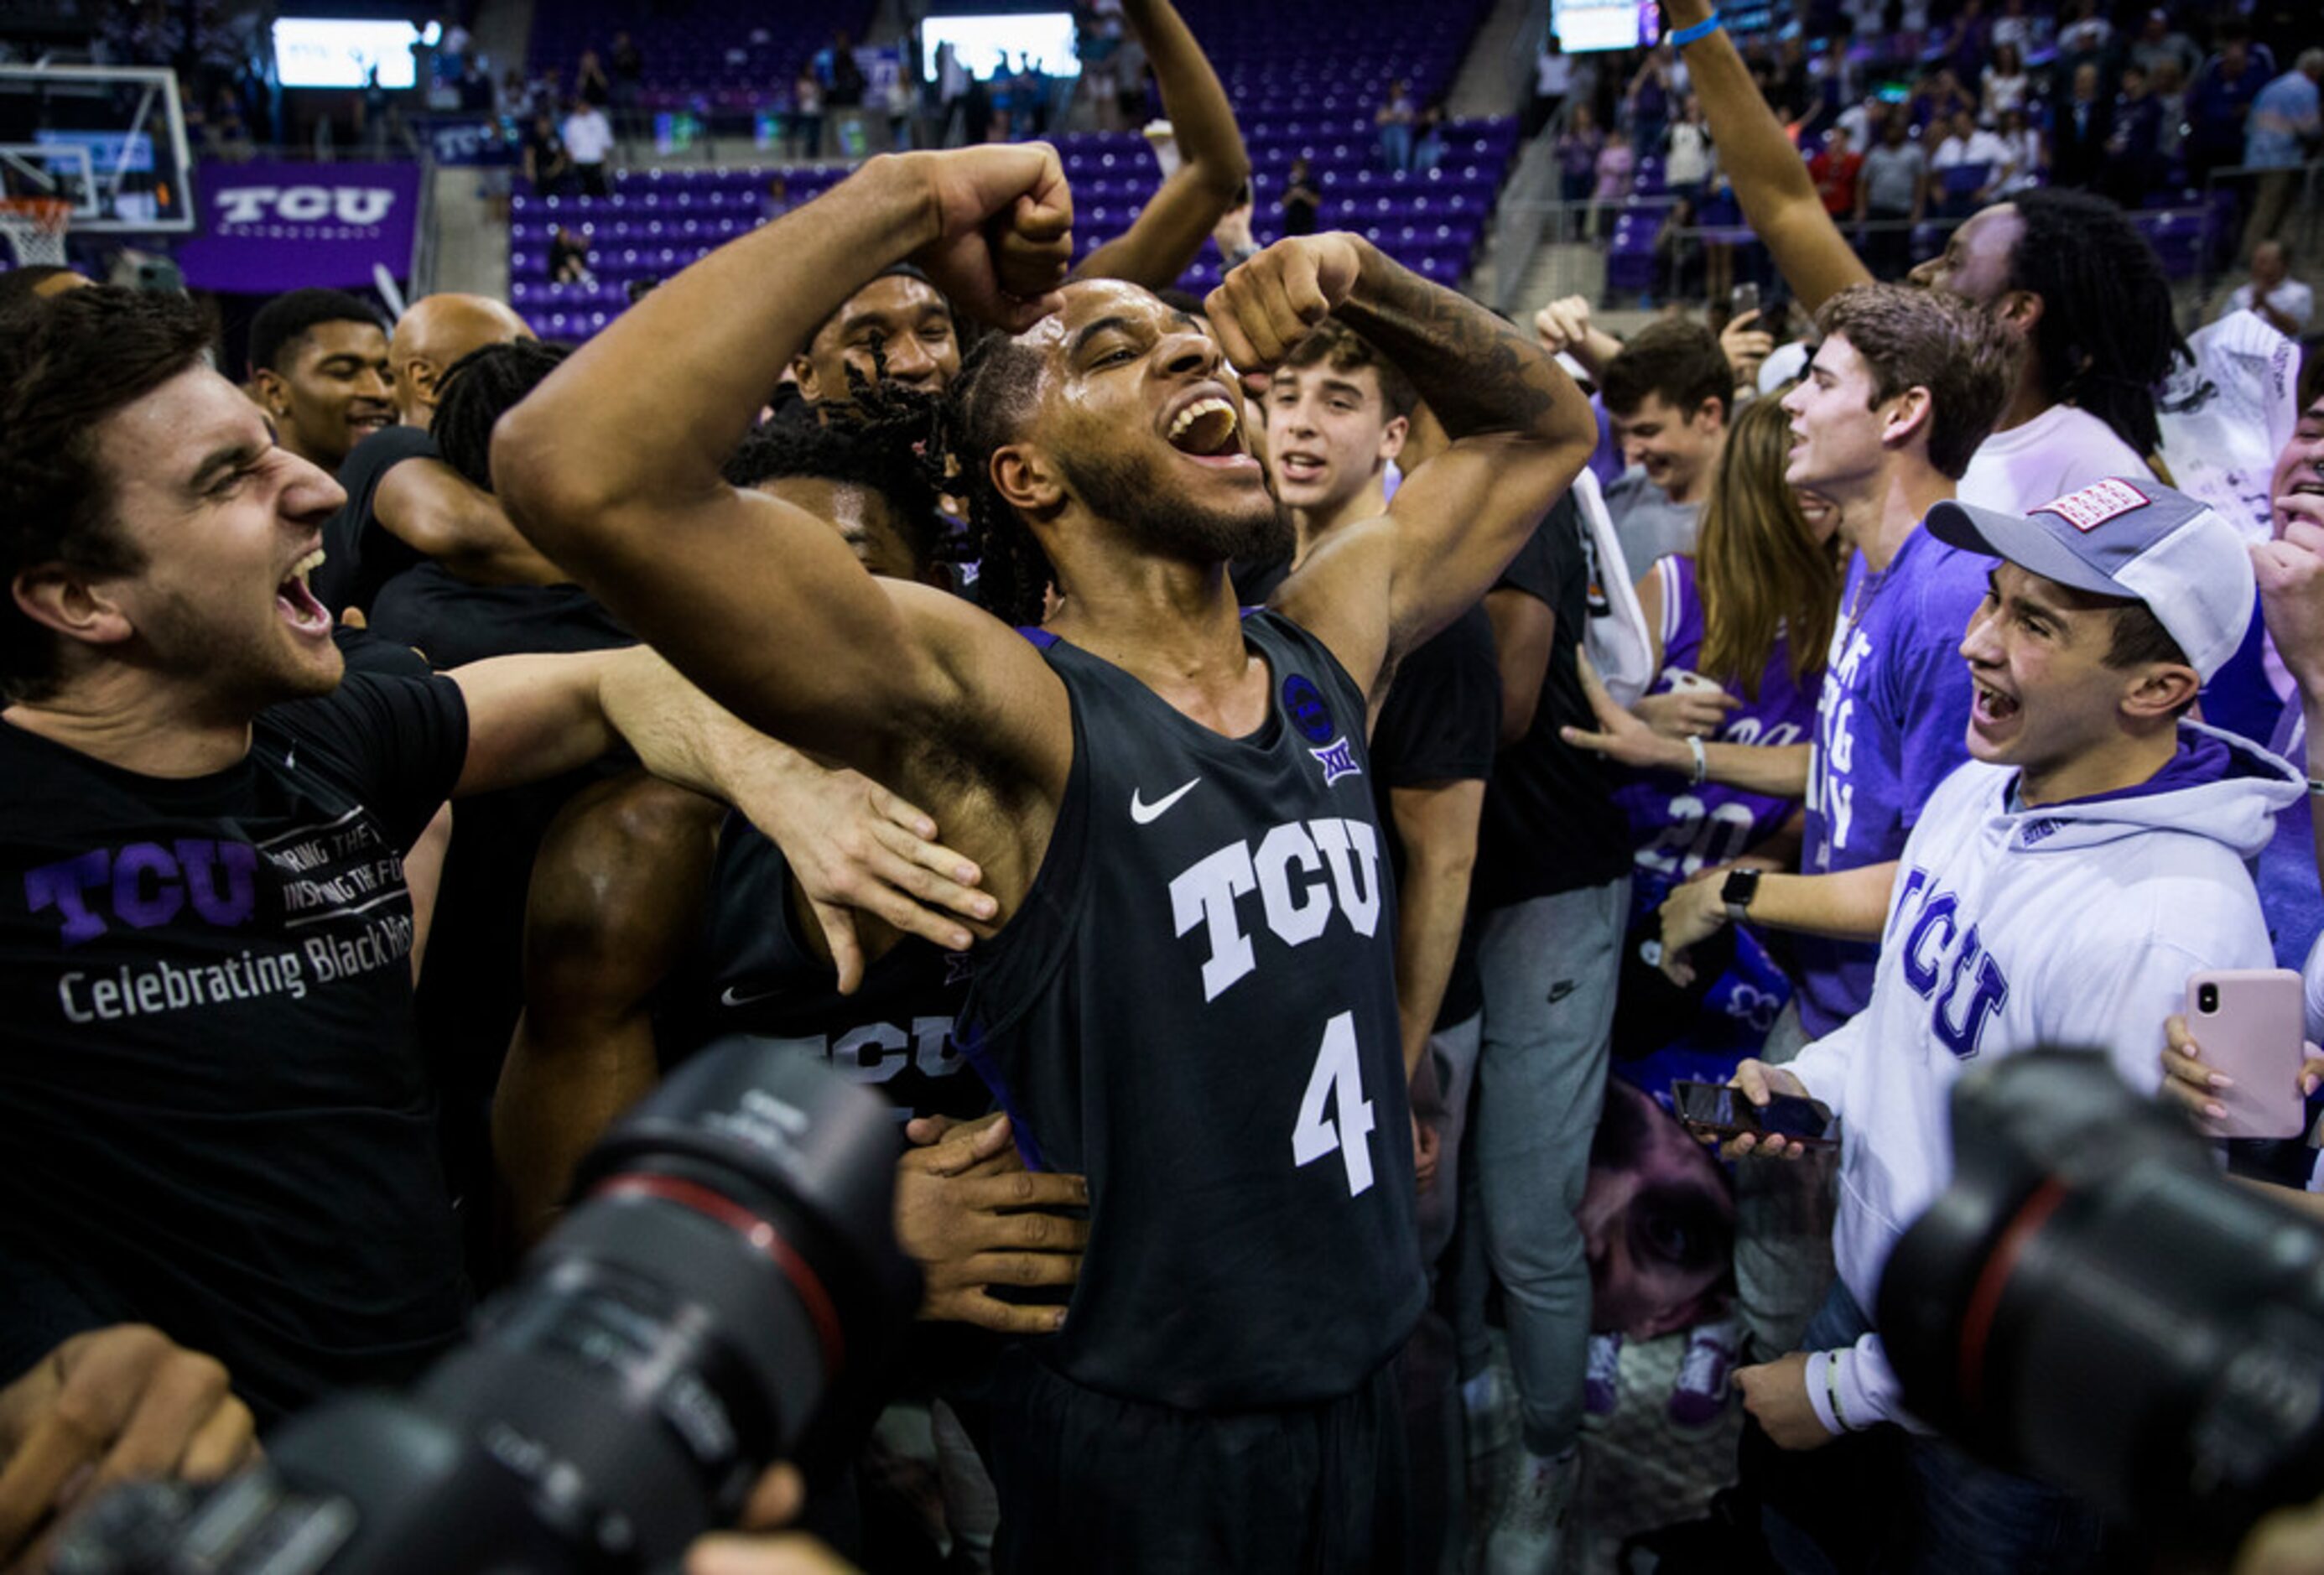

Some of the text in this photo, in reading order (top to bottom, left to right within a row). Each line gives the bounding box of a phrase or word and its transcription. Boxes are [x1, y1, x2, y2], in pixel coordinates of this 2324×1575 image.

[215, 186, 395, 225] TCU
[23, 838, 258, 946] TCU
[1168, 817, 1381, 1003] TCU
[58, 950, 307, 1024] Celebrating
[304, 924, 389, 983] Black
[746, 1016, 964, 1084] CU
[1292, 1010, 1375, 1197] 4
